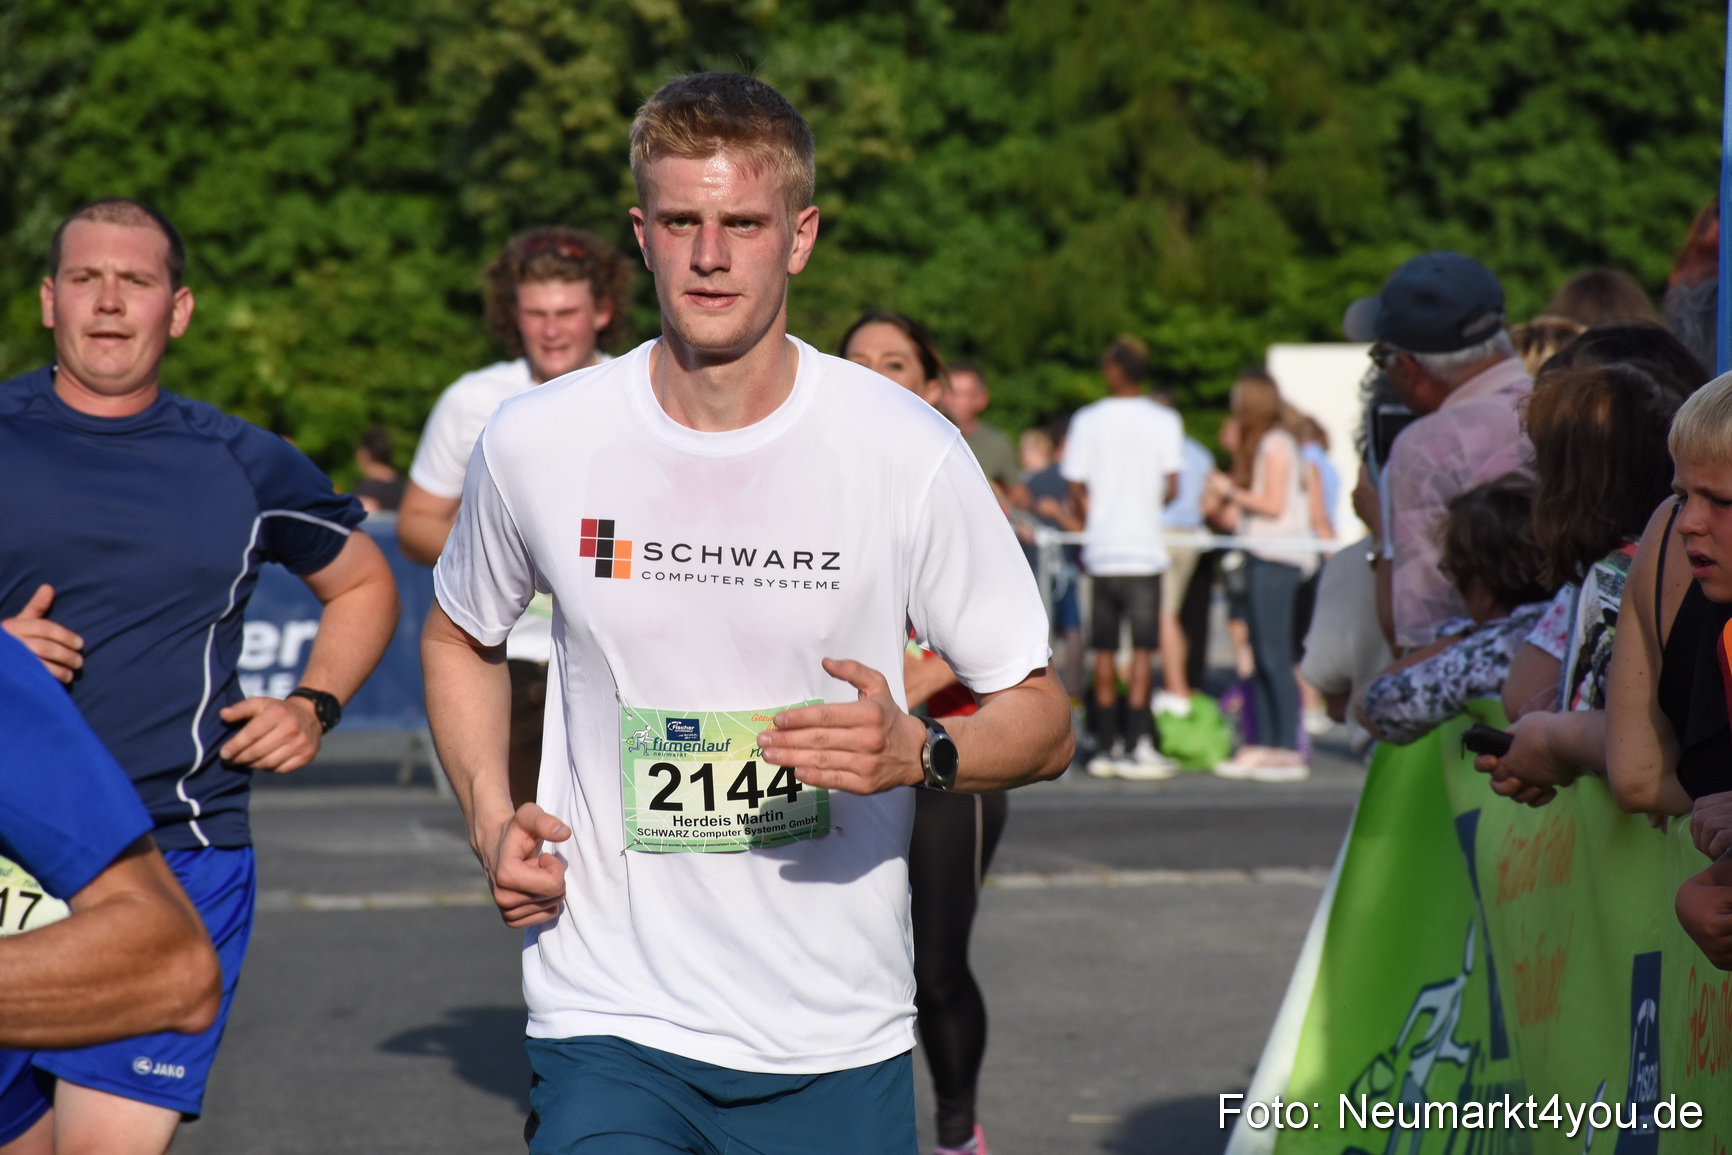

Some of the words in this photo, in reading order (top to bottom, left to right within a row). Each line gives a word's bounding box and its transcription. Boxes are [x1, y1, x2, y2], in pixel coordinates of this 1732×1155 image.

[643, 541, 841, 571] SCHWARZ
[641, 571, 745, 586] COMPUTER
[753, 577, 841, 590] SYSTEME
[653, 738, 732, 753] firmenlauf
[648, 760, 803, 811] 2144
[637, 827, 690, 838] SCHWARZ
[692, 829, 742, 839] Computer
[744, 824, 787, 837] Systeme
[789, 815, 818, 829] GmbH
[672, 815, 731, 827] Herdeis
[737, 810, 784, 825] Martin
[152, 1062, 185, 1079] JAKO
